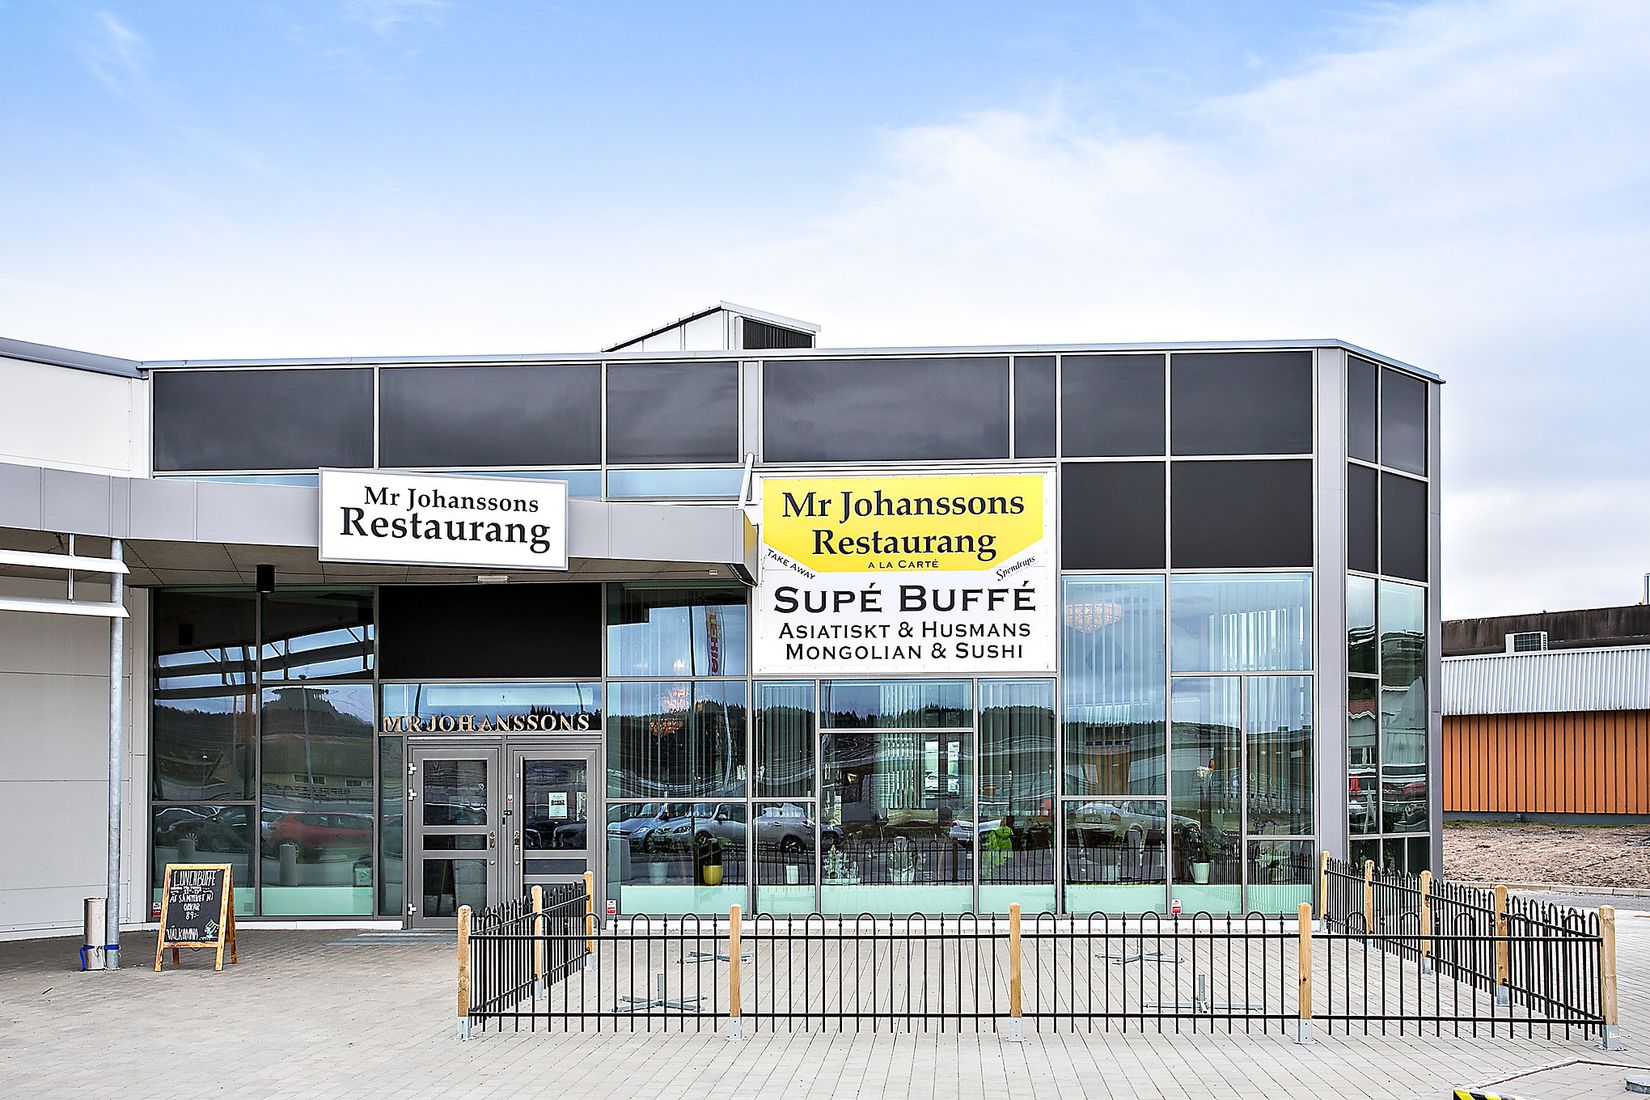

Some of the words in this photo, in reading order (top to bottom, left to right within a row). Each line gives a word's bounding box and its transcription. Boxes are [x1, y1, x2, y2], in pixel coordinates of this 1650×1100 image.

[364, 485, 400, 507] Mr
[406, 488, 539, 513] Johanssons
[782, 491, 832, 518] Mr
[839, 490, 1025, 524] Johanssons
[340, 506, 551, 554] Restaurang
[812, 529, 997, 562] Restaurang
[767, 548, 790, 567] TAKE
[789, 563, 816, 580] AWAY
[867, 561, 876, 569] A
[879, 561, 894, 569] LA
[897, 558, 939, 569] CARTÉ
[773, 581, 883, 614] SUPÉ
[899, 578, 1036, 613] BUFFÉ
[778, 622, 891, 639] ASIATISKT
[898, 621, 914, 638] &
[922, 620, 1031, 638] HUSMANS
[786, 643, 922, 660] MONGOLIAN
[931, 642, 947, 659] &
[955, 641, 1023, 659] SUSHI
[382, 714, 422, 733] MR
[425, 713, 591, 732] JOHANSSONS
